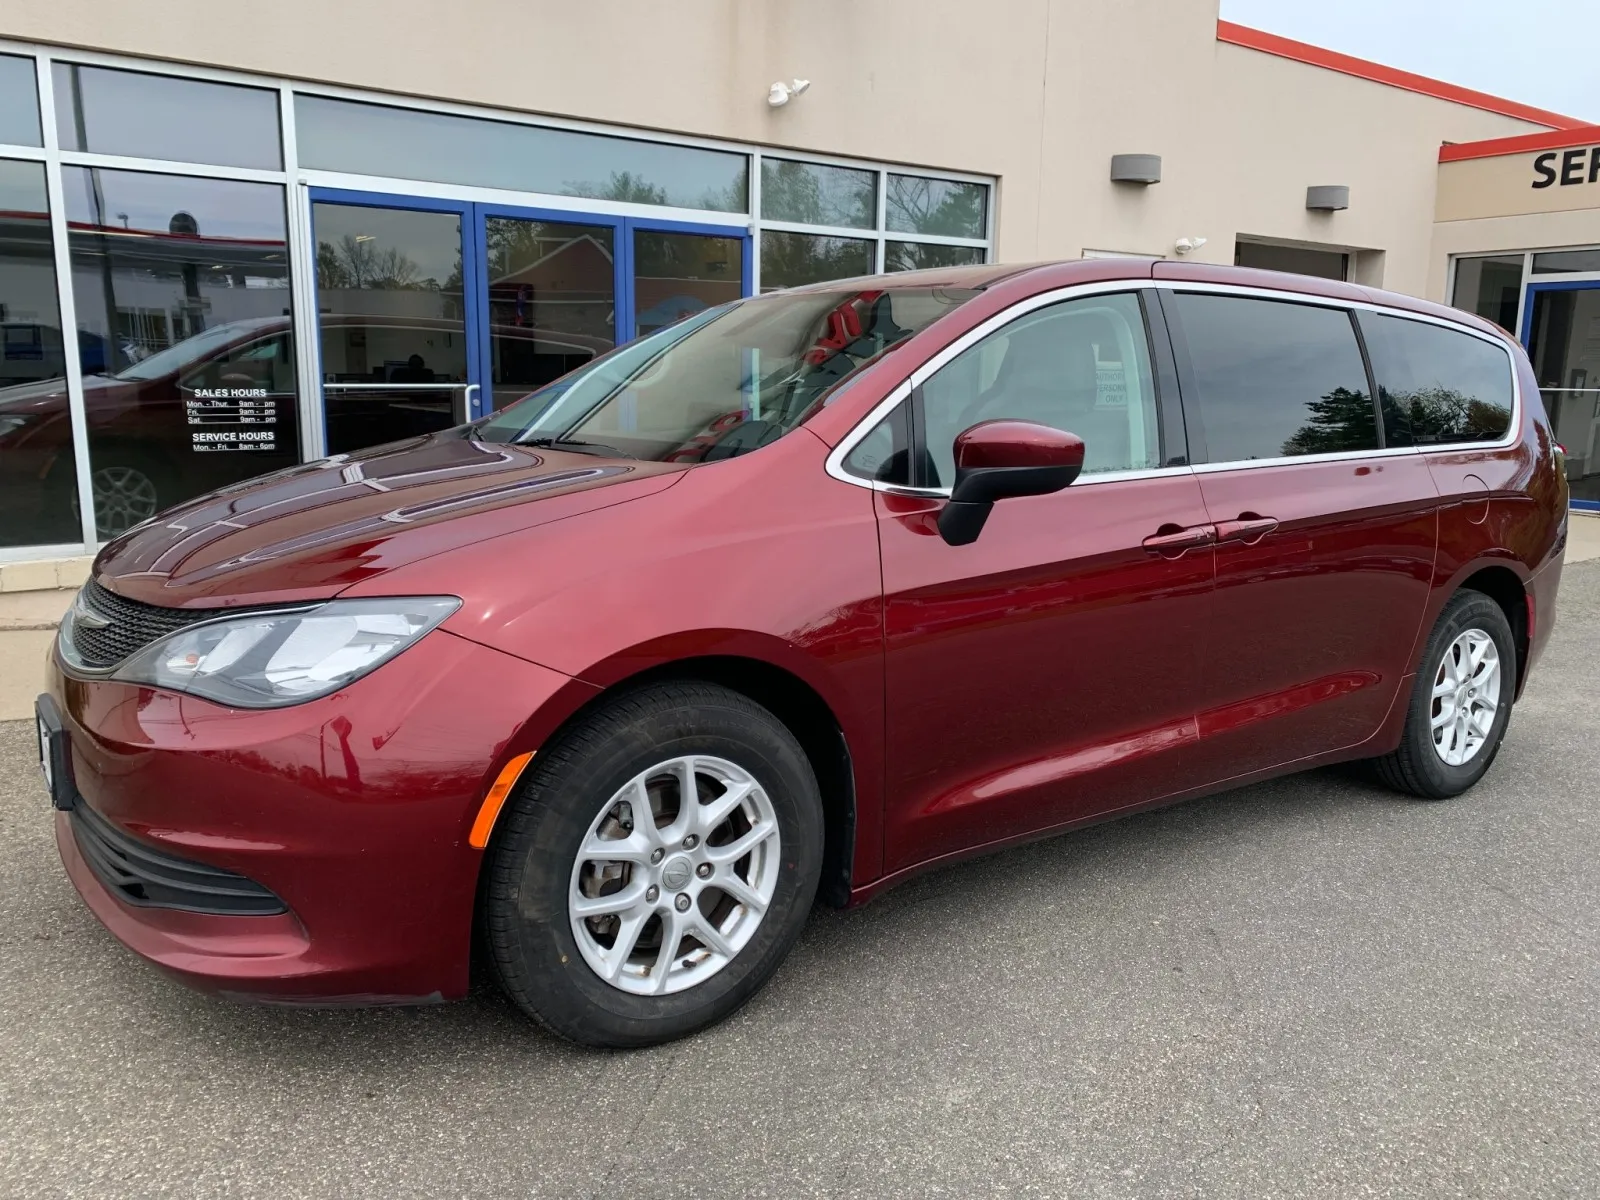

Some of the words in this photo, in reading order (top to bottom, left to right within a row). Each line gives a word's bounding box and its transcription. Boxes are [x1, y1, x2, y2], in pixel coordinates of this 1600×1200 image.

[194, 388, 229, 397] SALES
[230, 388, 267, 397] HOURS
[192, 433, 237, 441] SERVICE
[238, 431, 275, 441] HOURS
